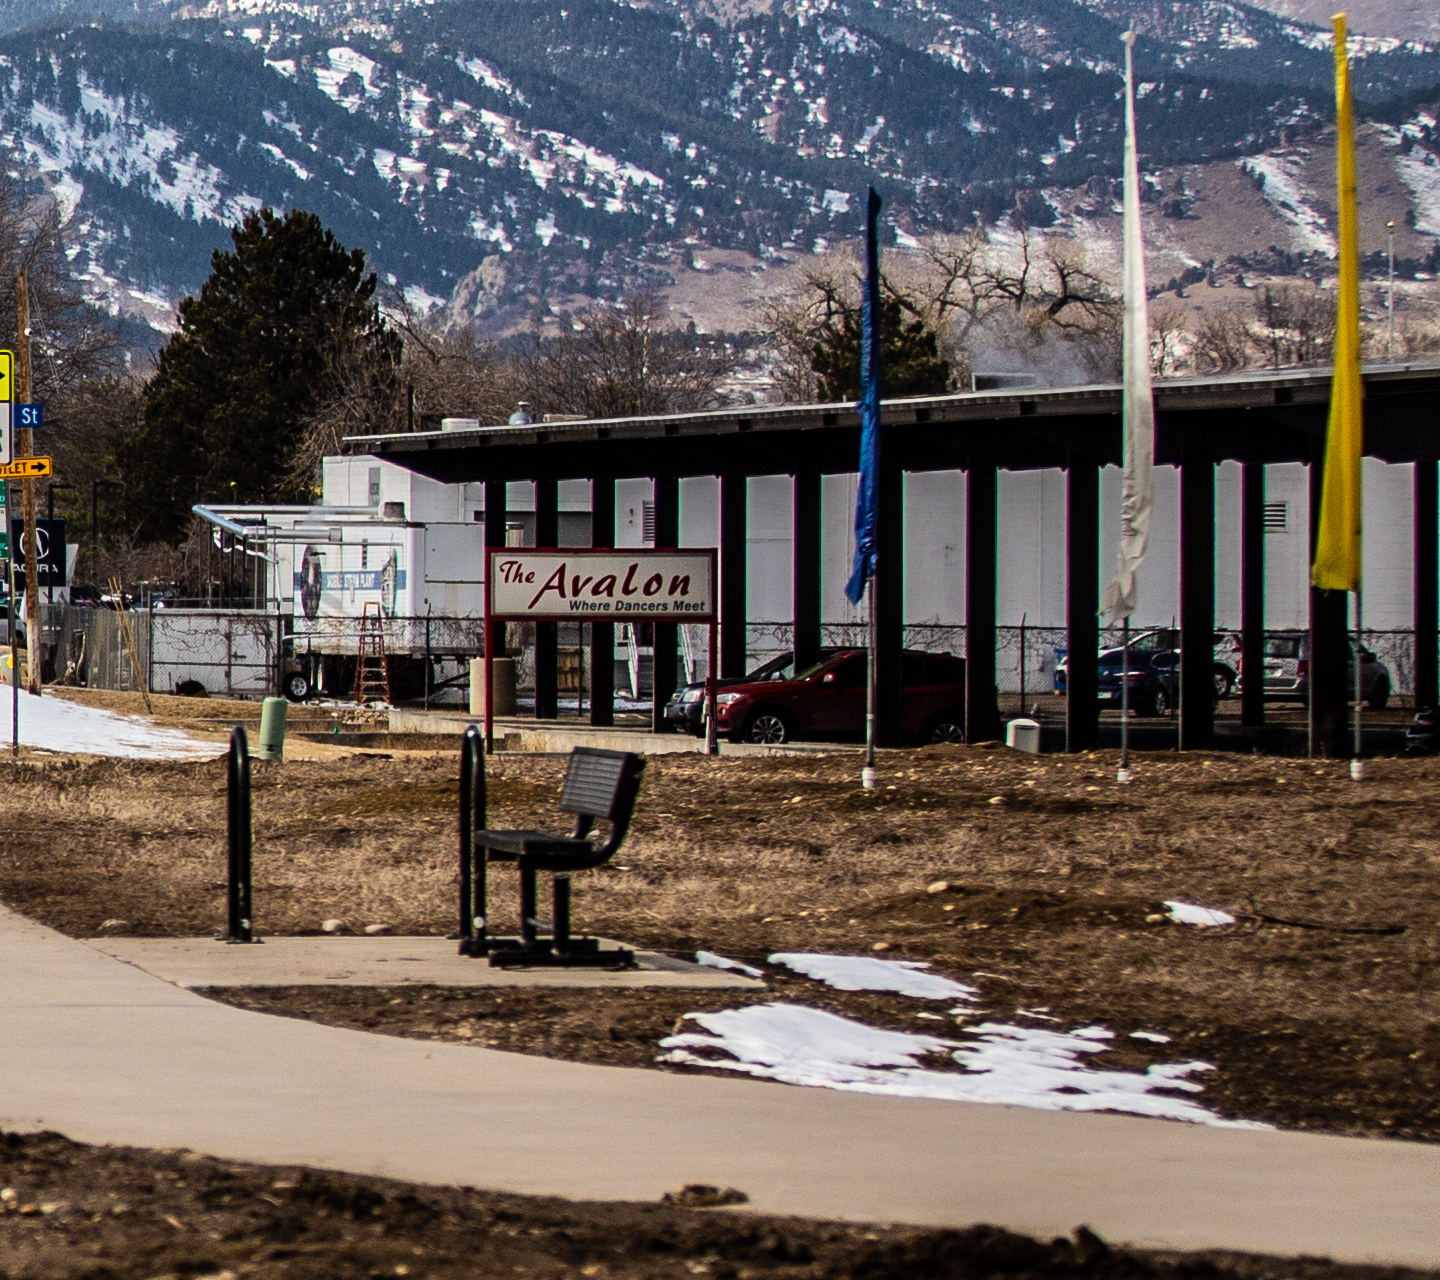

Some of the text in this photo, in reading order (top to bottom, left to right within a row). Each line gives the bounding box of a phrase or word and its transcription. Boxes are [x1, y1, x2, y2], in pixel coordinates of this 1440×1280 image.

[21, 407, 38, 424] St
[13, 563, 58, 572] ACRA
[499, 560, 691, 609] The Avalon
[569, 600, 706, 612] Where Dancers Meet
